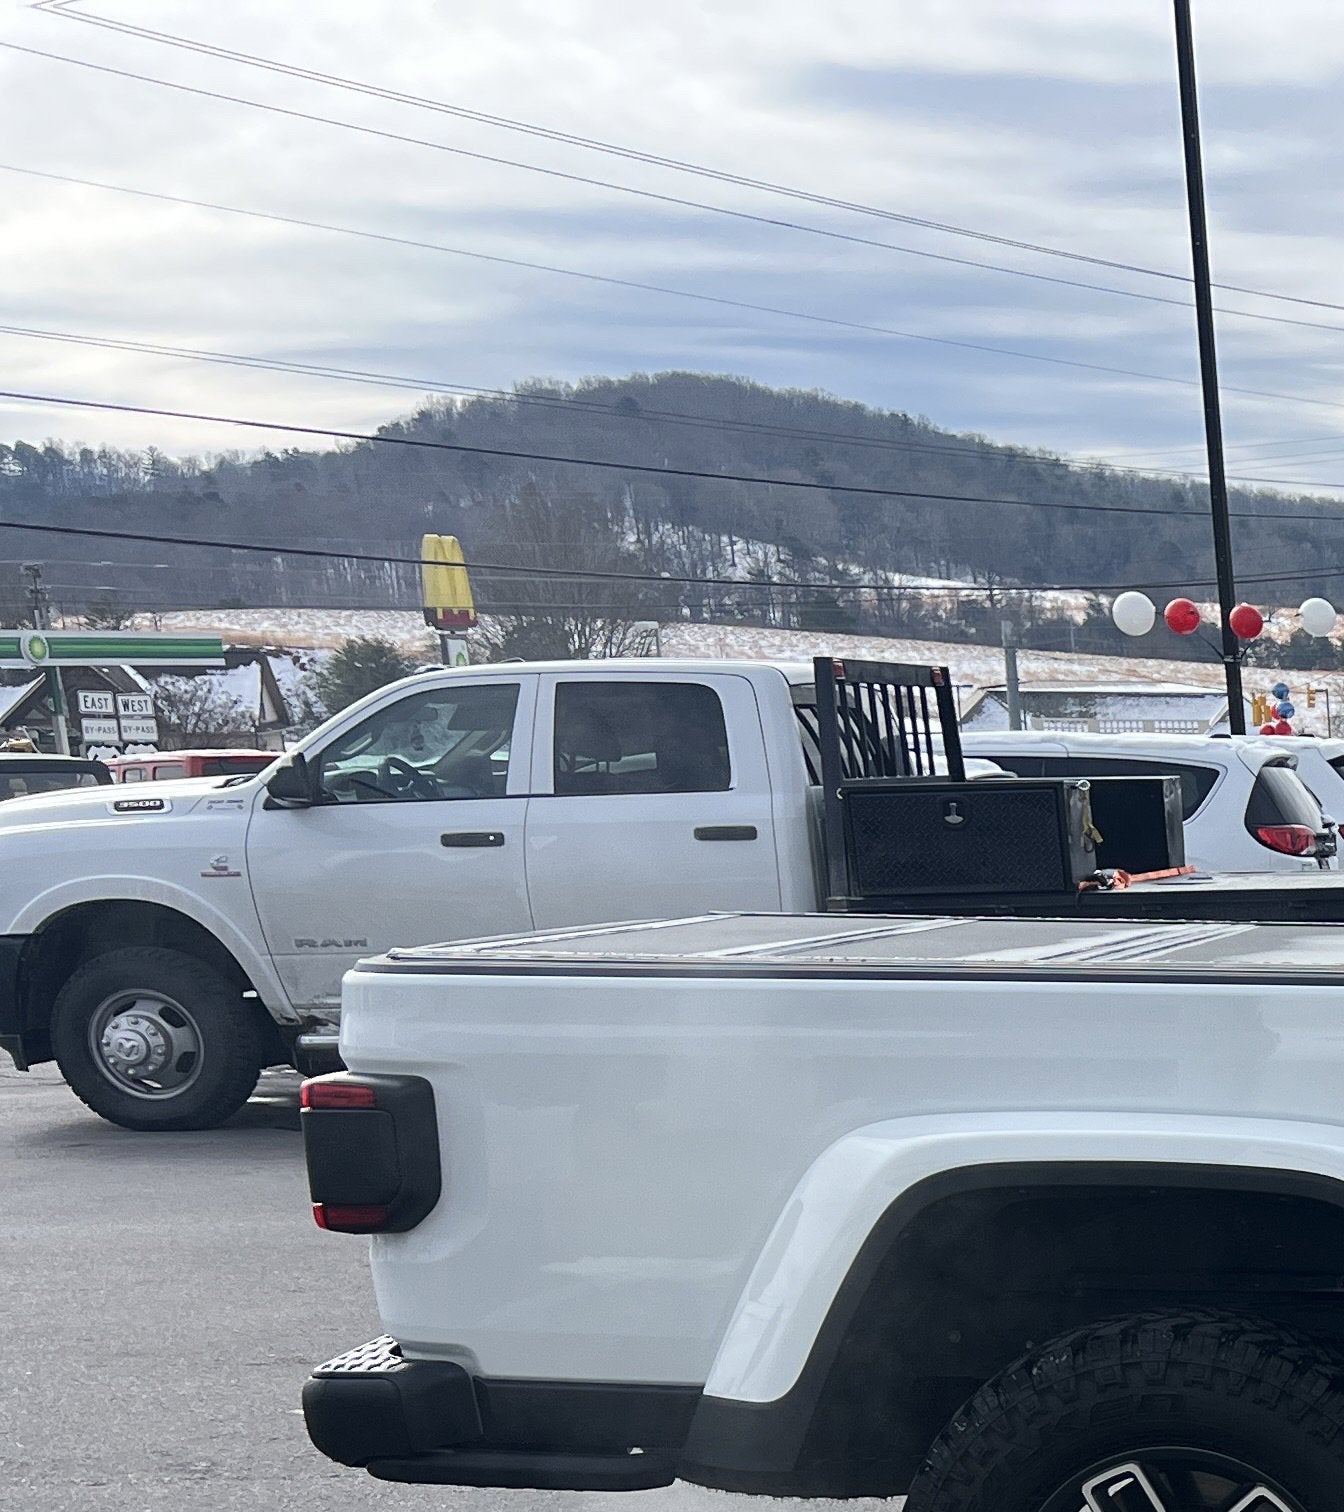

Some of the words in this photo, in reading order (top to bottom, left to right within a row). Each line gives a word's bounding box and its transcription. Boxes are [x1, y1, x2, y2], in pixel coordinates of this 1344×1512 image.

[83, 694, 109, 710] EAST
[120, 698, 150, 713] WEST
[84, 725, 117, 735] BY-PASS
[122, 725, 155, 735] BY-PASS
[118, 800, 161, 808] 3500
[294, 937, 368, 948] RAM
